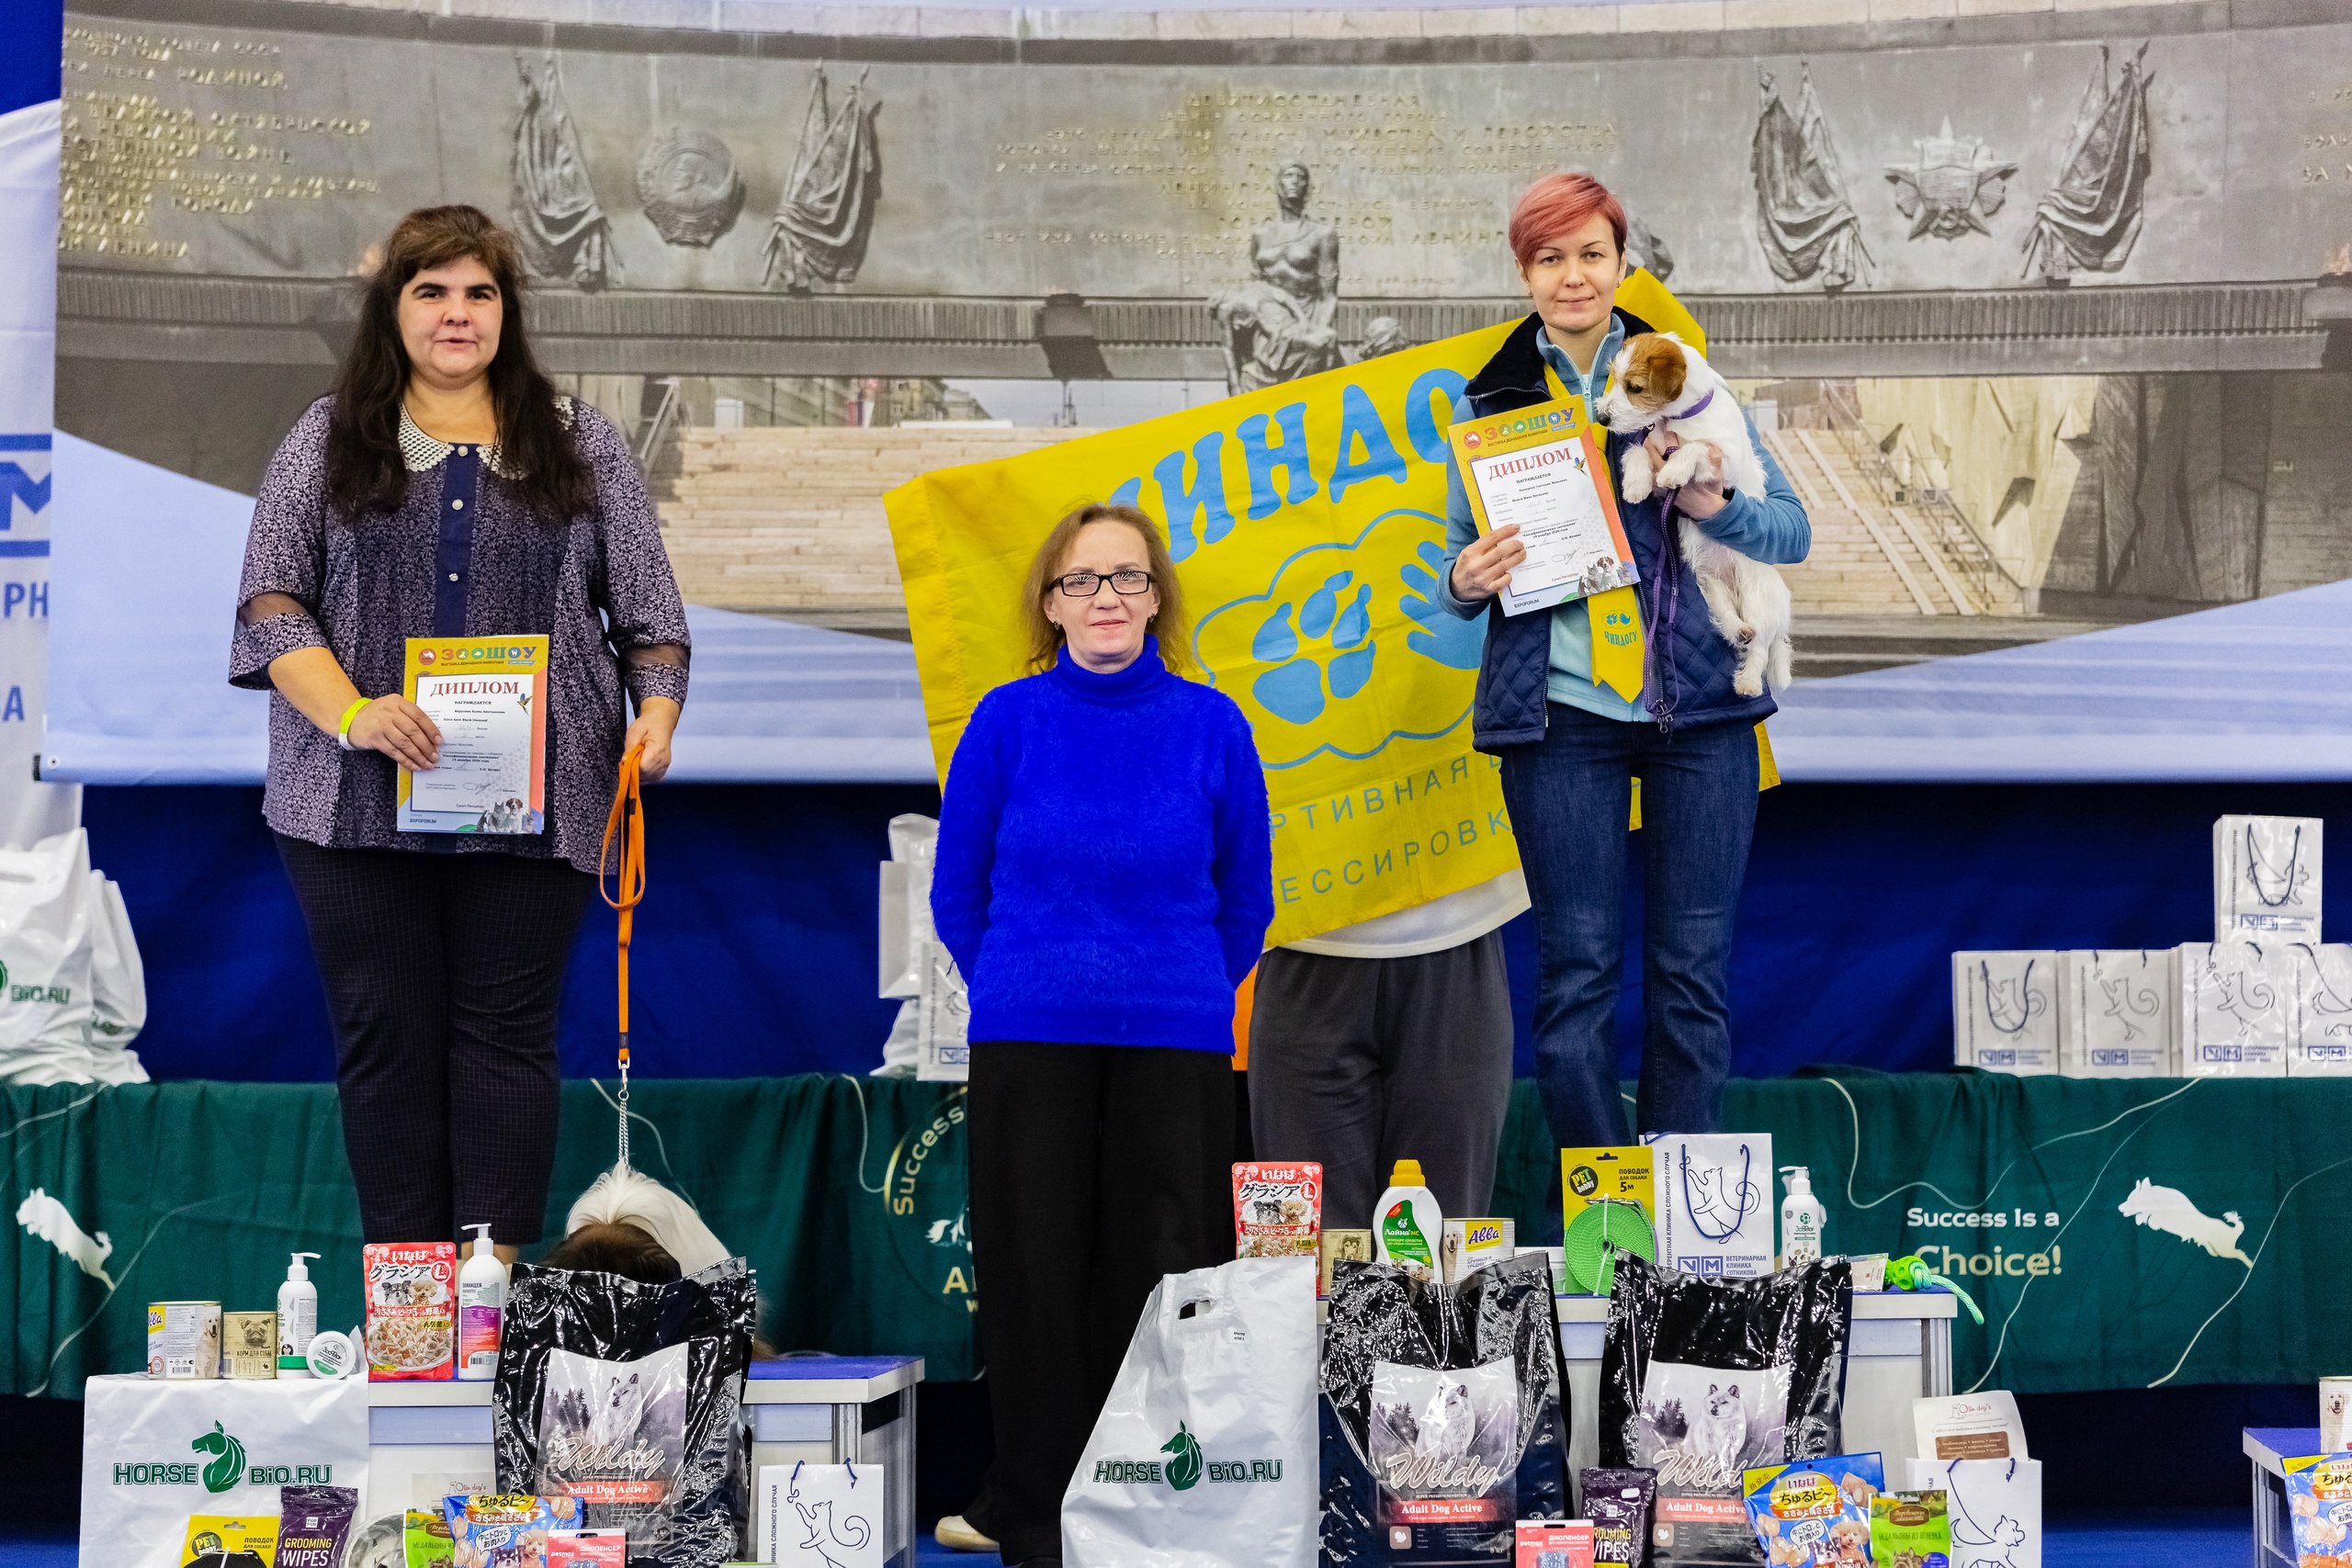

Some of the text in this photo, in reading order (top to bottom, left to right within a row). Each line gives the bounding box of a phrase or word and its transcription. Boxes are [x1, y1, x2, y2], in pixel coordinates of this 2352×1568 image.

[1488, 446, 1573, 482] ДИПЛОМ
[429, 681, 520, 697] ДИПЛОМ
[892, 1105, 966, 1216] Success
[1570, 1168, 1593, 1188] PET
[1664, 1179, 1672, 1208] СЛОЖНОГО
[1906, 1207, 2060, 1228] Success Is a
[1914, 1244, 2063, 1277] Choice!
[112, 1462, 199, 1486] HORSE
[1092, 1461, 1164, 1484] HORSE
[1385, 1452, 1499, 1498] Wildy
[1652, 1449, 1748, 1489] Wild
[567, 1484, 649, 1496] Adult Dog Active
[770, 1484, 778, 1508] СЛУЧАЯ
[1401, 1503, 1483, 1515] Adult Dog Active
[1666, 1502, 1747, 1514] Adult Dog Active
[770, 1508, 778, 1541] СЛОЖНОГО
[195, 1534, 218, 1551] PET
[284, 1537, 333, 1550] GROOMING
[281, 1550, 331, 1567] WIPES
